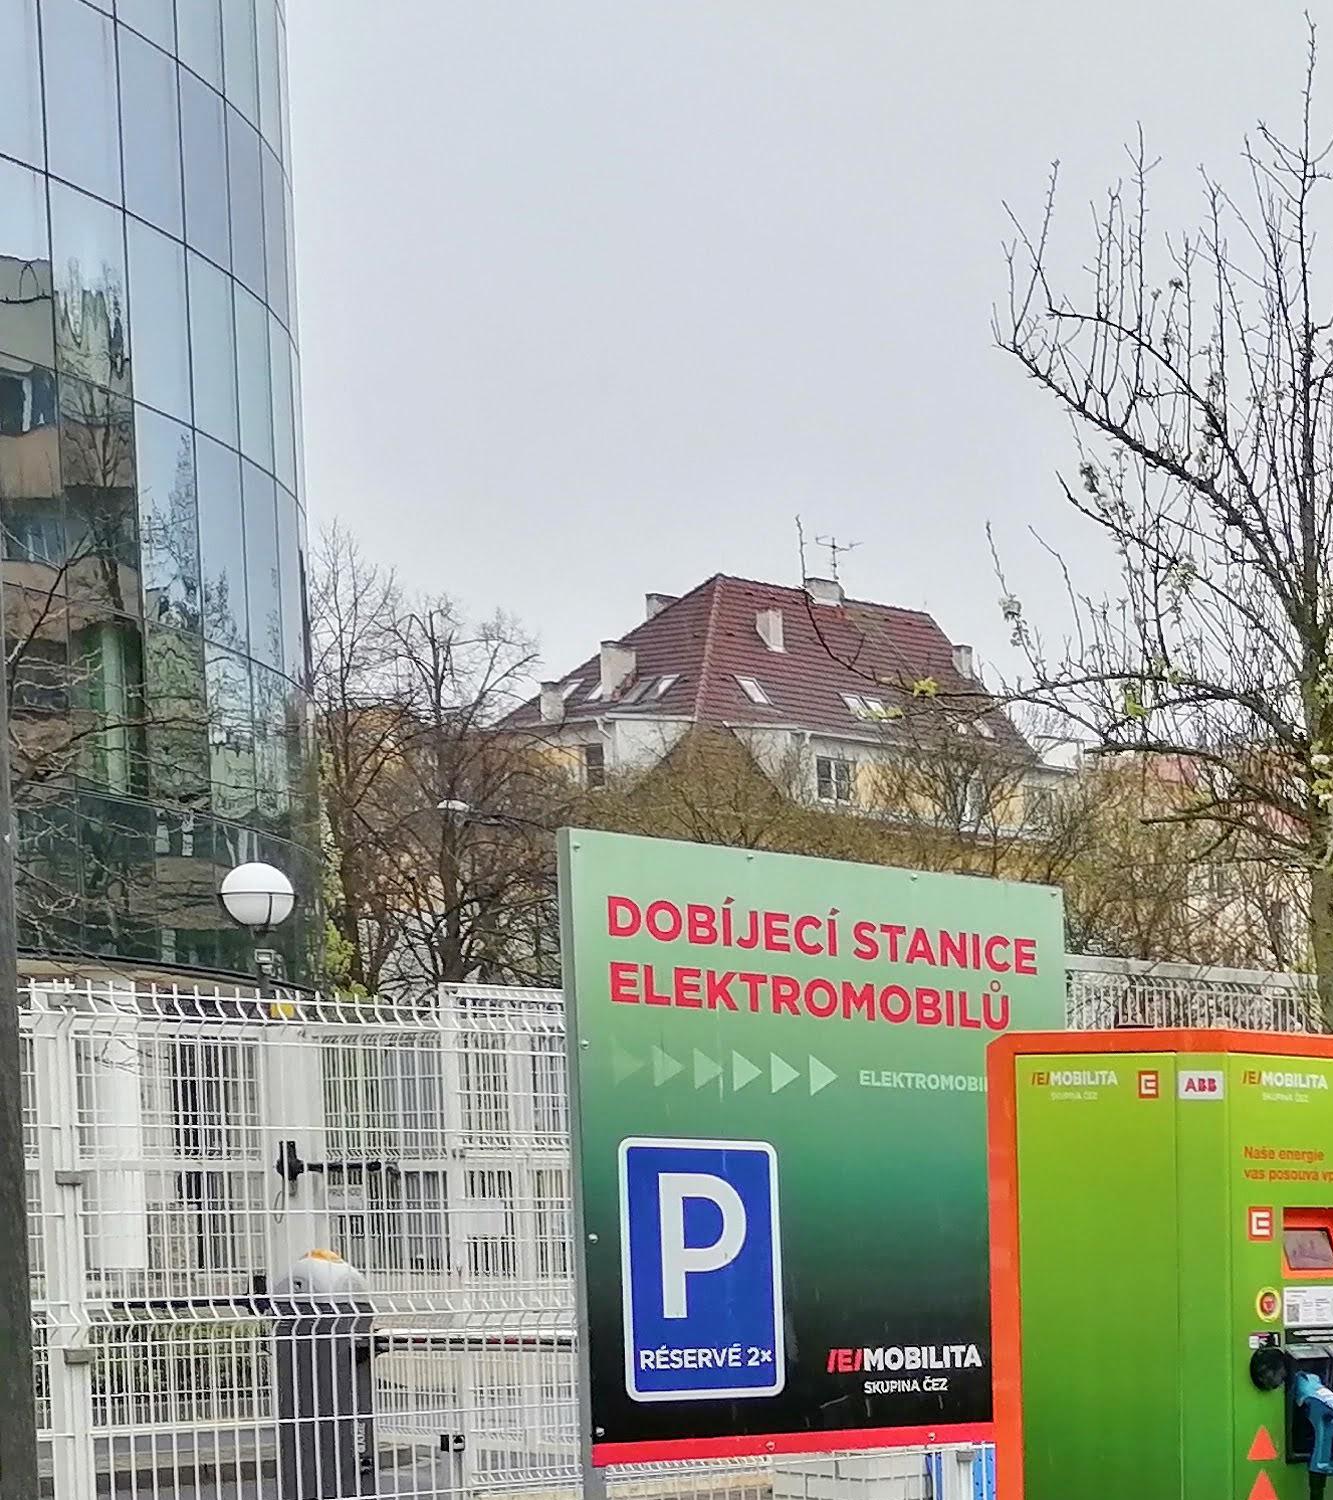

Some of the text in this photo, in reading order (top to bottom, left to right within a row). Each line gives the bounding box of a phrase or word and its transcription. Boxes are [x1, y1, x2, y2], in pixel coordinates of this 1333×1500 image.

[607, 896, 1038, 976] DOBÍJECÍ STANICE
[609, 962, 1010, 1031] ELEKTROMOBILŮ
[1185, 1078, 1217, 1093] ABB
[1279, 1149, 1325, 1164] energie
[658, 1172, 747, 1319] P
[640, 1344, 742, 1370] RÉSERVÉ
[864, 1376, 948, 1394] SKUPINA ČEZ
